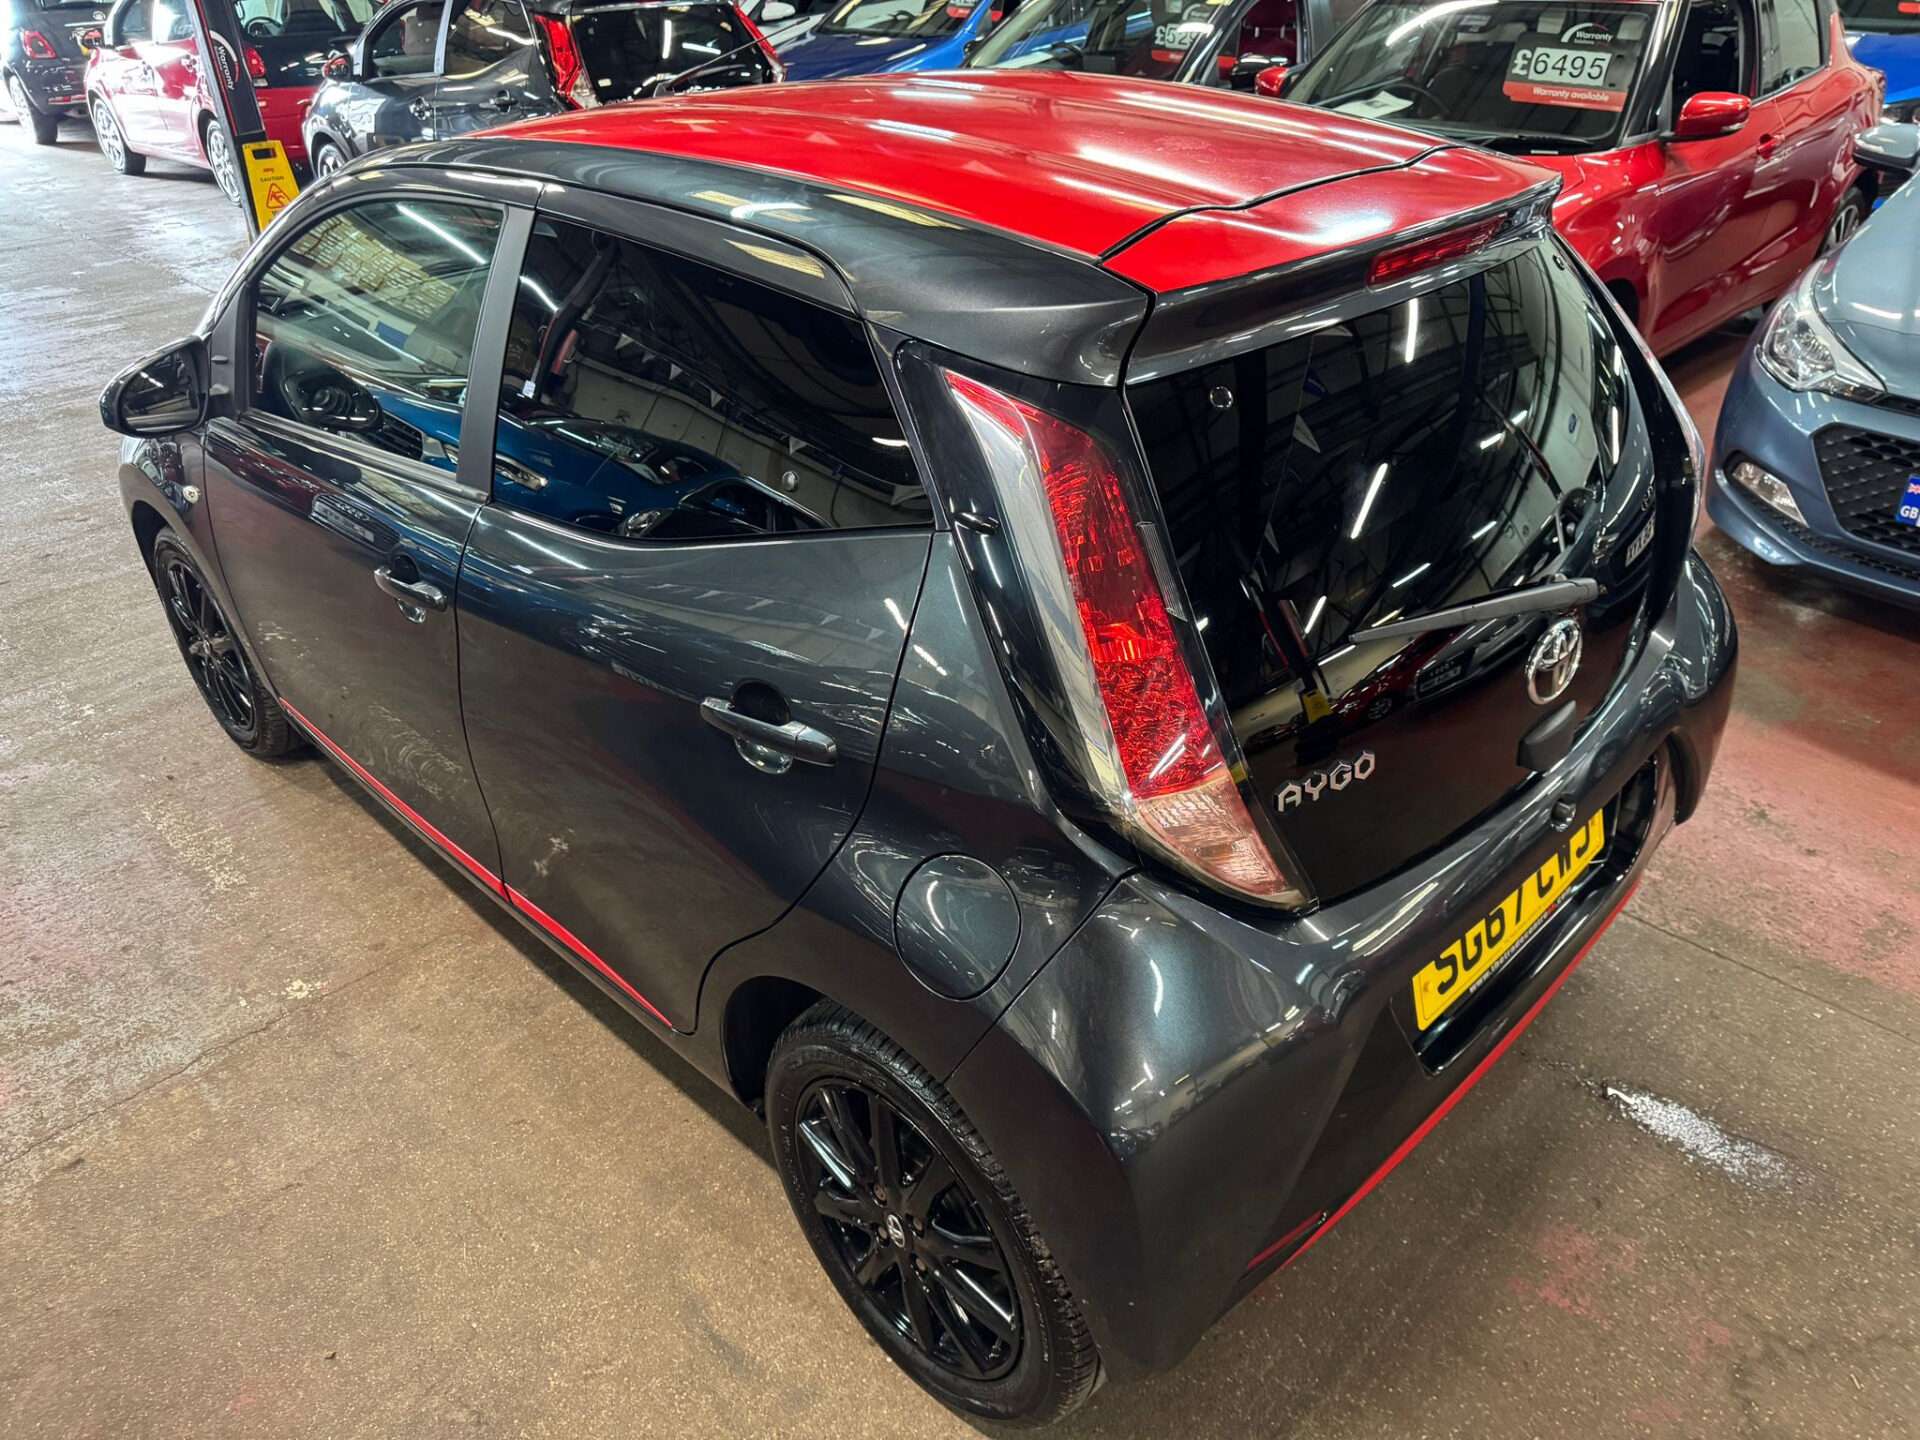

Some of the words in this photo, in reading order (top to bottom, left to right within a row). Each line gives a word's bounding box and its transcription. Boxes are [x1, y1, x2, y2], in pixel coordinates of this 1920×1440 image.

[1576, 31, 1614, 42] Warranty
[218, 46, 235, 90] Warranty
[1512, 49, 1606, 80] £6495
[1533, 87, 1569, 98] Warranty
[1571, 92, 1609, 102] available
[1900, 505, 1919, 519] GB
[1277, 750, 1375, 812] AYGO
